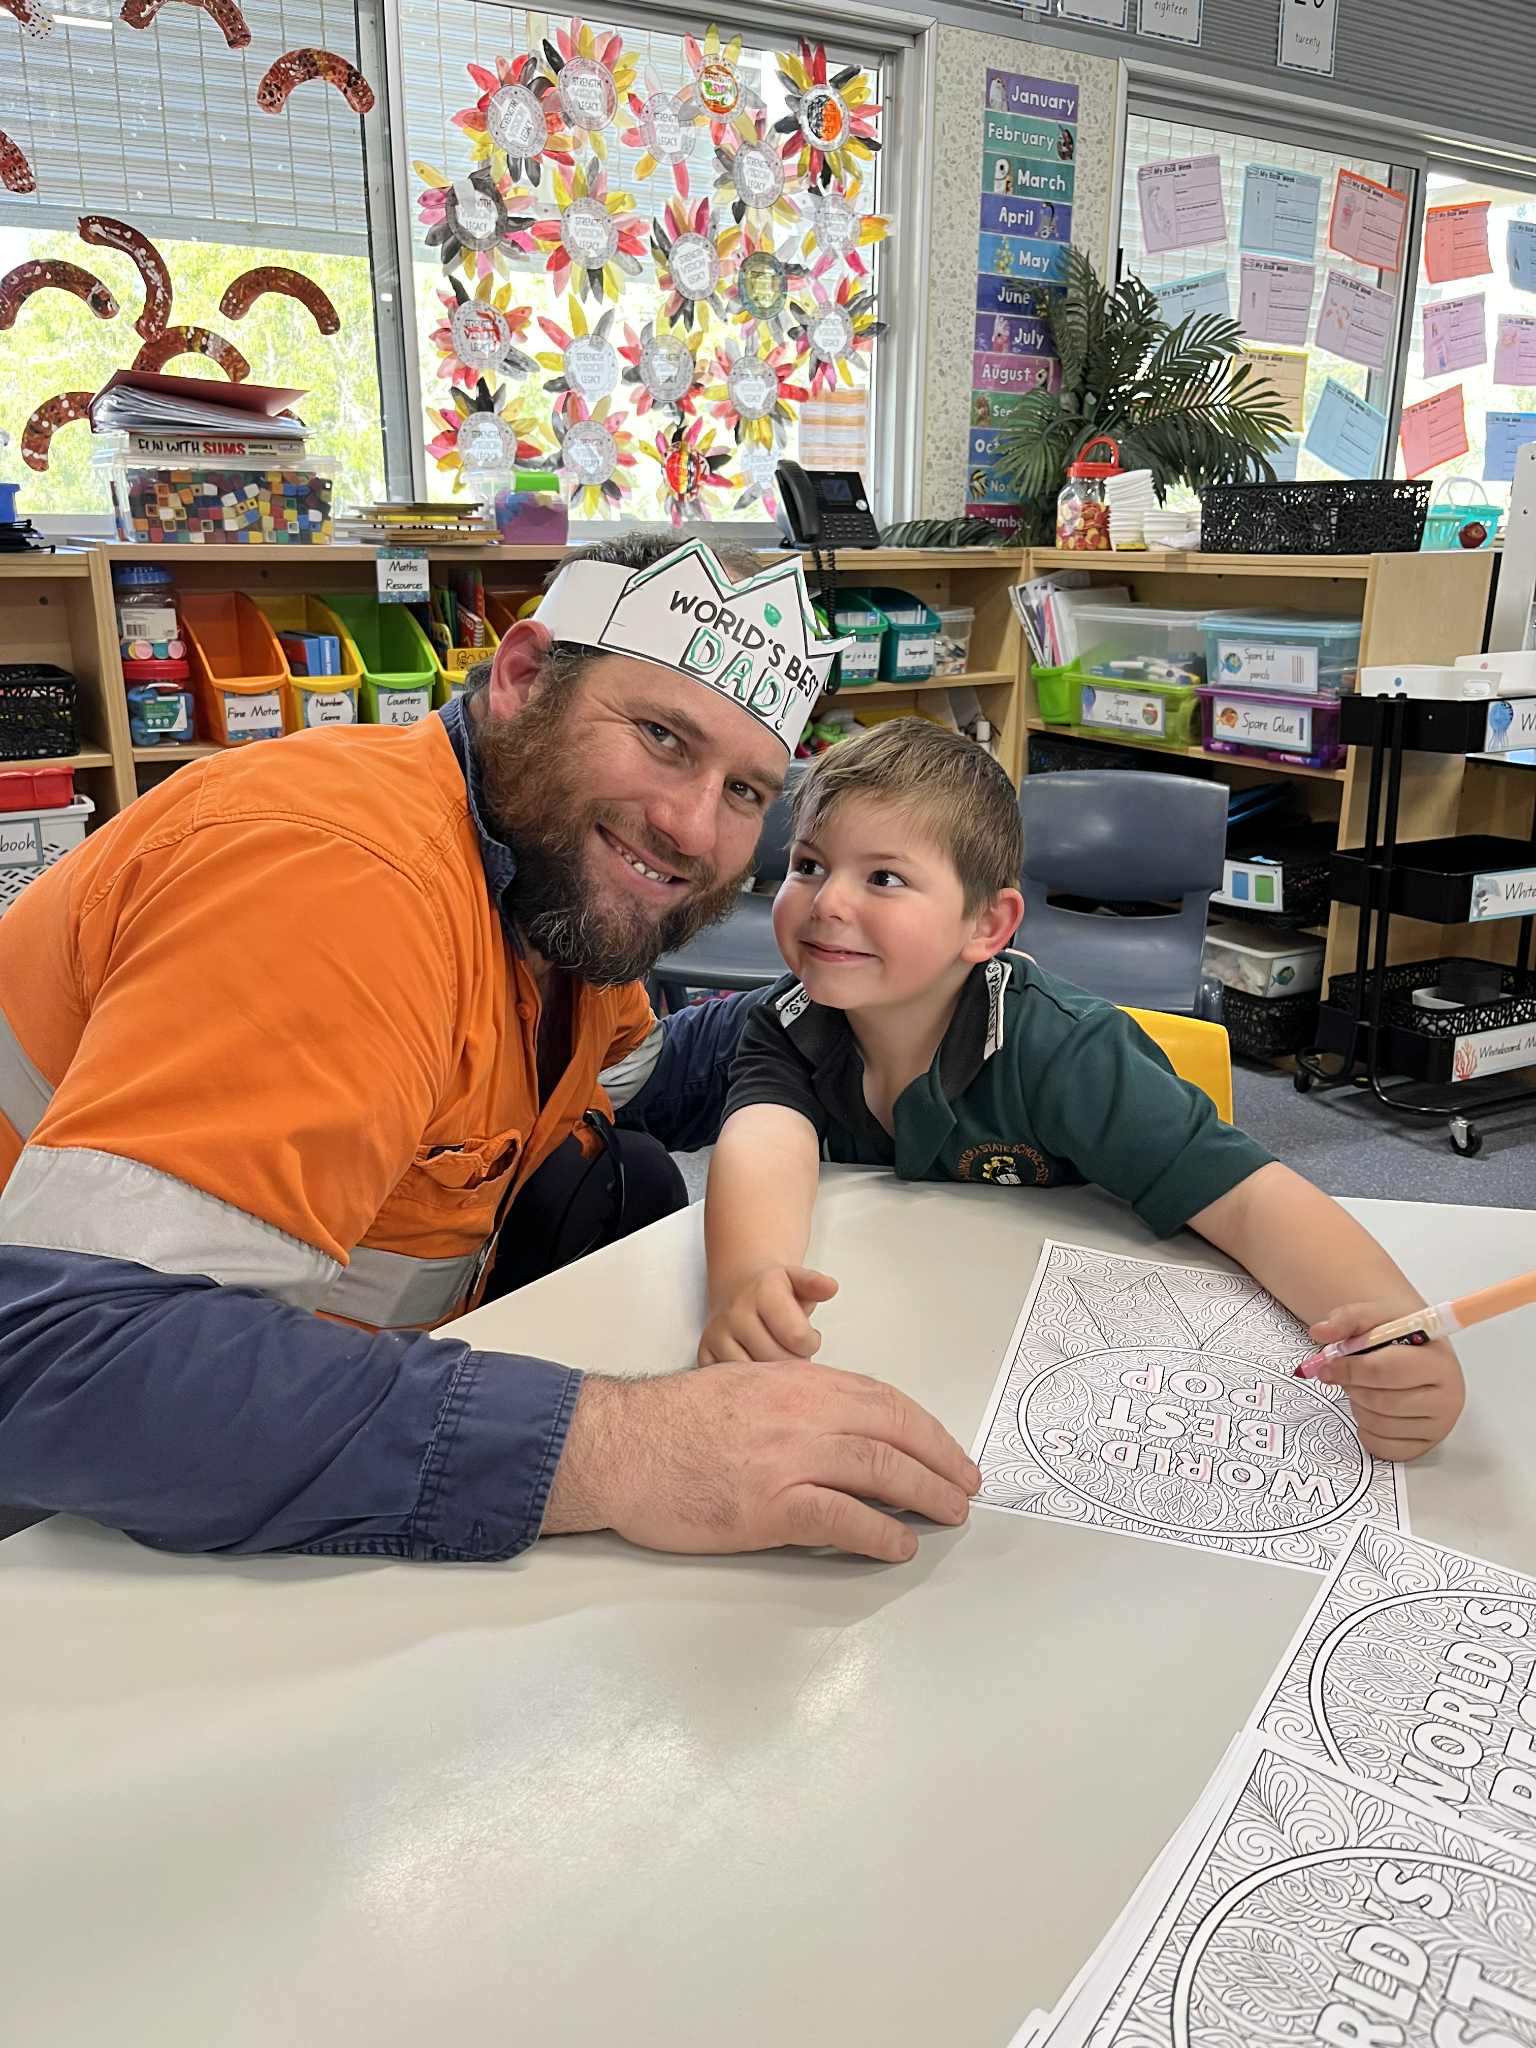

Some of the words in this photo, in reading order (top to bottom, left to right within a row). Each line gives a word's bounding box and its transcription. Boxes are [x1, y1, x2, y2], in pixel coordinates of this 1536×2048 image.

[1011, 85, 1075, 116] January
[988, 122, 1054, 151] February
[1017, 169, 1066, 192] March
[998, 206, 1034, 228] April
[1019, 250, 1050, 273] May
[997, 286, 1031, 304] June
[1014, 327, 1044, 350] July
[981, 363, 1031, 385] August
[138, 438, 163, 455] FUN
[167, 439, 199, 455] WITH
[203, 442, 246, 456] SUMS
[389, 561, 418, 573] Maths
[386, 578, 423, 591] Resources
[668, 590, 786, 668] WORLD'S
[784, 655, 820, 703] BEST
[315, 698, 343, 708] Number
[386, 695, 421, 706] Counters
[227, 706, 246, 719] Fine
[251, 705, 280, 718] Motor
[391, 712, 399, 723] &
[1242, 712, 1268, 735] Spare
[1272, 716, 1295, 734] Glue
[1119, 1363, 1274, 1412] POP
[1096, 1396, 1286, 1459] BEST
[1041, 1427, 1338, 1507] WORLD'S
